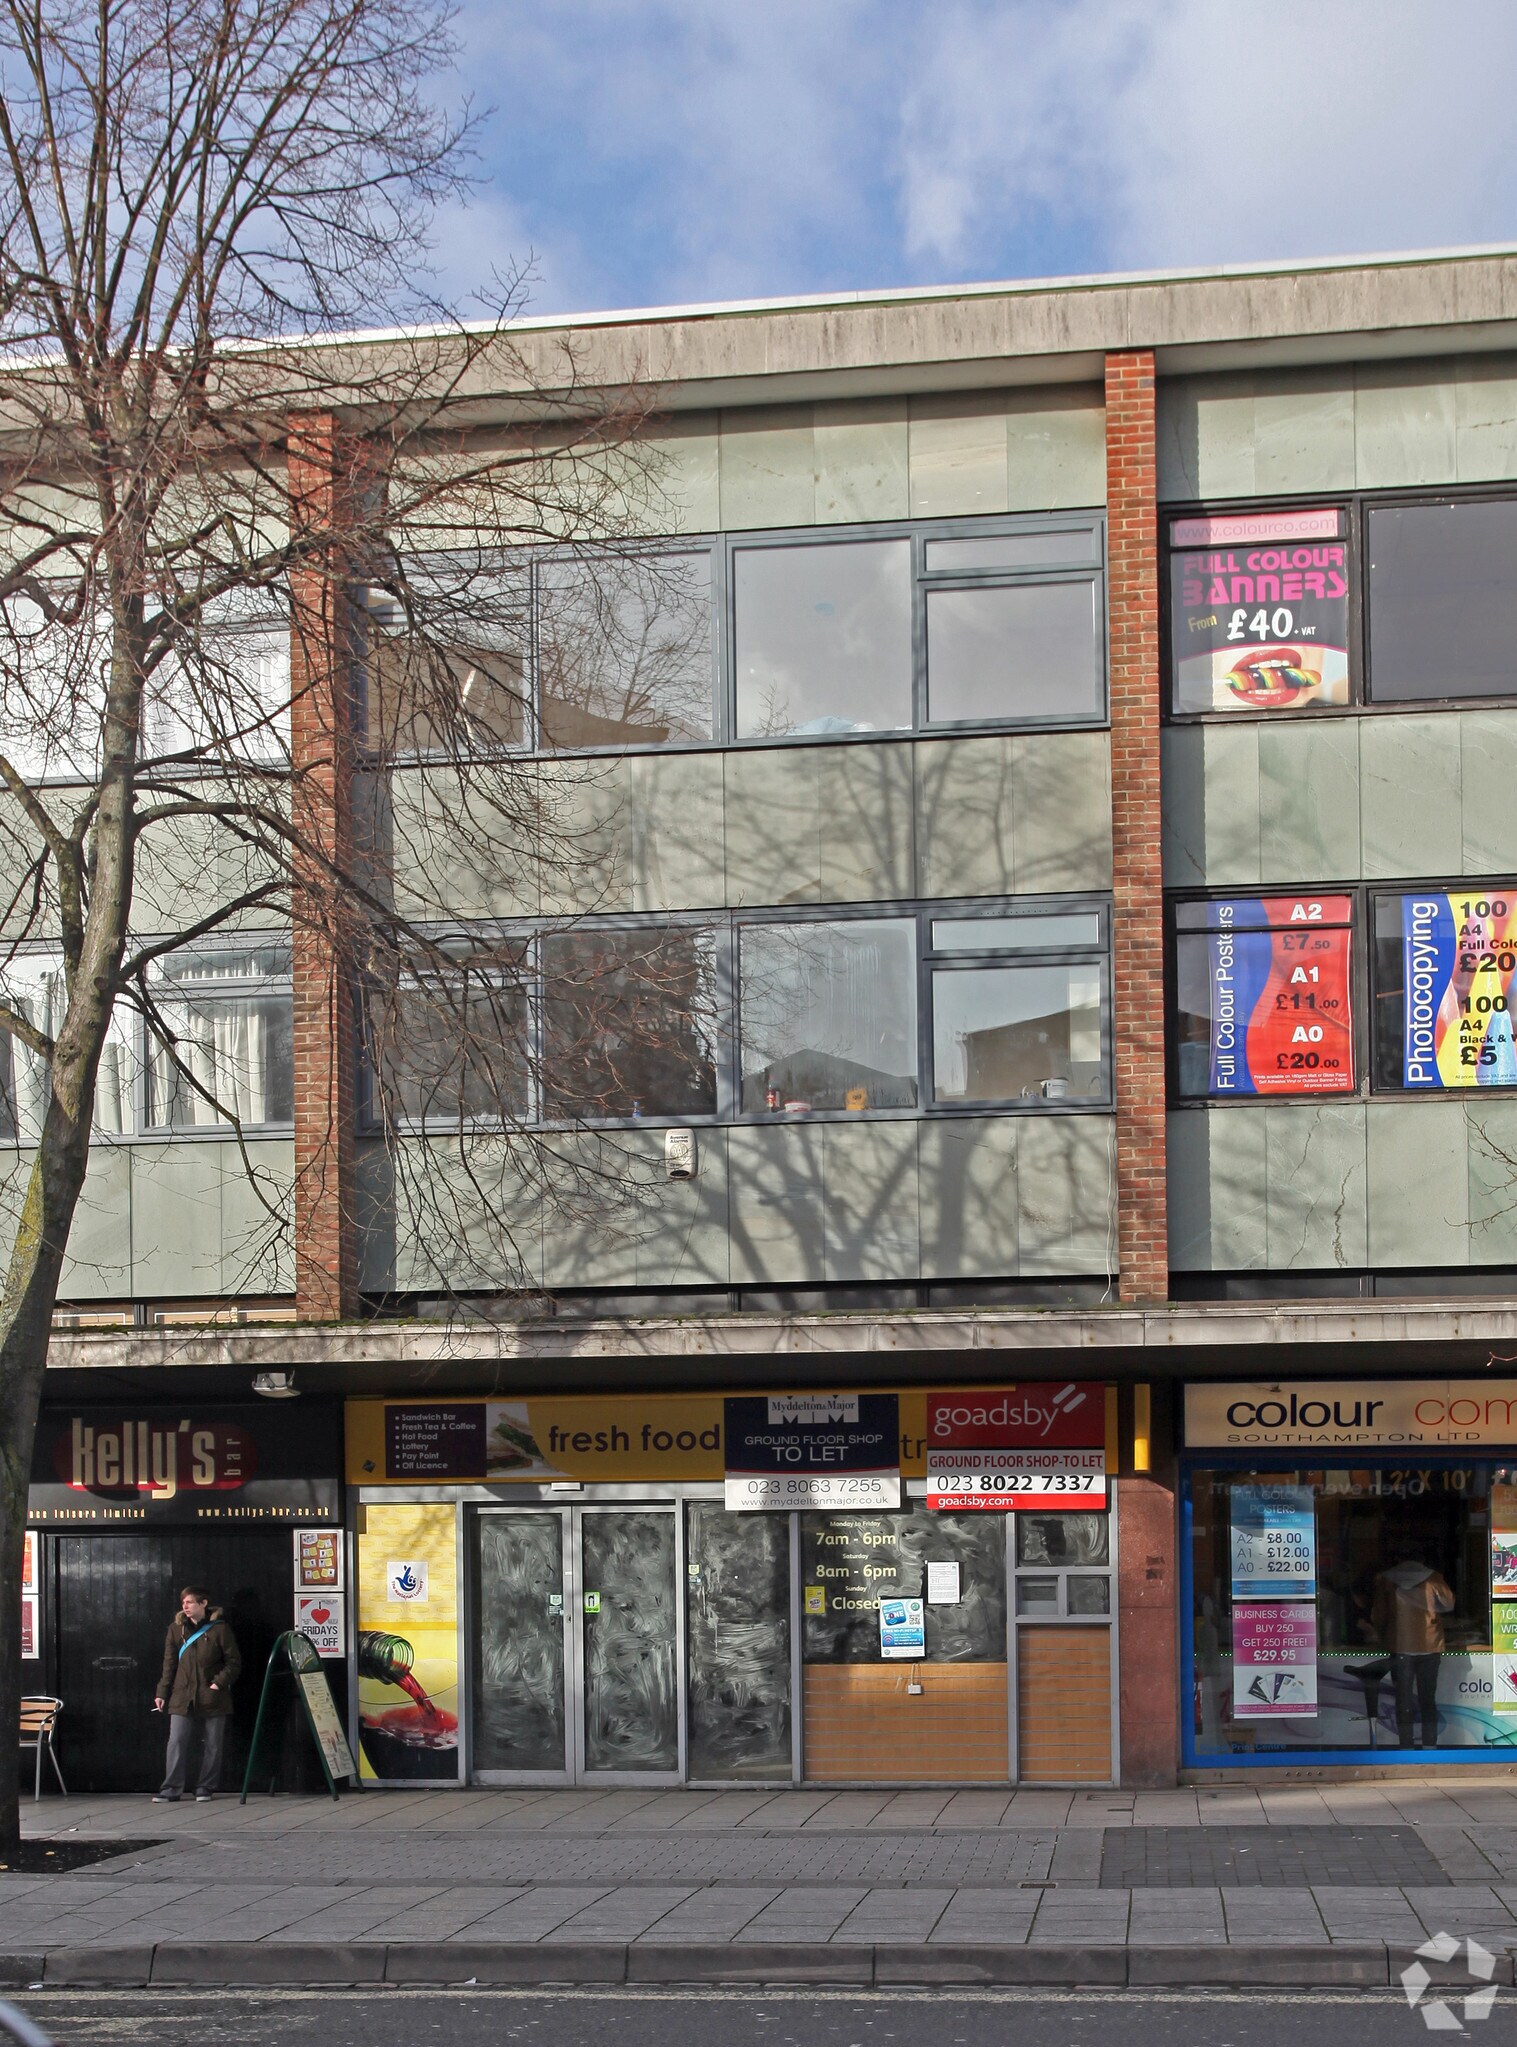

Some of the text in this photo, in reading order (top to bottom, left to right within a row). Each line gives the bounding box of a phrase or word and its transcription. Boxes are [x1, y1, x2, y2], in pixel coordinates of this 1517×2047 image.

[1177, 518, 1336, 540] www.colourco.com
[1184, 548, 1343, 575] FULL COLOUR
[1183, 571, 1347, 606] BANNERS
[1188, 615, 1218, 632] From
[1226, 607, 1293, 641] £40
[1301, 626, 1315, 635] VAT
[1290, 903, 1322, 921] A2
[1460, 900, 1507, 918] 100
[1459, 924, 1482, 936] A4
[1282, 934, 1330, 951] £7.50
[1459, 939, 1485, 951] Full
[1459, 952, 1516, 973] £20
[1290, 967, 1319, 983] A1
[1215, 906, 1235, 1089] Full Colour Posters
[1407, 901, 1439, 1083] Photocopying
[1276, 993, 1338, 1010] £11.00
[1461, 995, 1508, 1014] 100
[1460, 1019, 1483, 1031] A4
[1292, 1026, 1323, 1042] A0
[1460, 1034, 1494, 1044] Black
[1497, 1034, 1507, 1043] &
[1277, 1053, 1339, 1069] £20.00
[1460, 1046, 1498, 1067] £5
[1226, 1393, 1384, 1427] colour
[402, 1413, 456, 1421] Sandwich Bar
[934, 1399, 1060, 1437] goadsby
[449, 1422, 477, 1430] Coffee
[549, 1425, 630, 1452] fresh
[641, 1424, 720, 1452] food
[744, 1434, 884, 1446] GROUND FLOOR SHOP
[1227, 1433, 1480, 1443] SOUTHAMPTON LTD
[402, 1443, 429, 1451] Lottery
[224, 1438, 241, 1476] bar
[420, 1452, 439, 1460] Point
[772, 1446, 849, 1462] TO LET
[930, 1455, 981, 1468] GROUND
[984, 1455, 1024, 1468] FLOOR
[1082, 1455, 1103, 1468] LET
[748, 1479, 882, 1494] 023 8063 7255
[937, 1475, 1095, 1491] 023 8022 7337
[741, 1496, 889, 1509] www.myddeltonmajor.co.uk
[938, 1496, 1014, 1509] goadsby.com
[1250, 1504, 1295, 1514] POSTERS
[54, 1508, 97, 1519] leisure
[103, 1508, 145, 1519] limited
[198, 1507, 329, 1518] www.kellys-bar.co.uk
[830, 1520, 854, 1528] Monday
[862, 1519, 881, 1528] Friday
[816, 1532, 849, 1545] 7am
[863, 1532, 896, 1548] 6pm
[1237, 1534, 1253, 1544] A2
[1267, 1533, 1302, 1544] £8.00
[1237, 1548, 1252, 1558] A1
[1267, 1547, 1310, 1558] £12.00
[816, 1564, 850, 1578] 8am
[863, 1564, 897, 1580] 6pm
[1237, 1562, 1254, 1573] A0
[1267, 1561, 1310, 1572] £22.00
[845, 1585, 868, 1593] Sunday
[832, 1596, 880, 1610] Closed
[885, 1610, 905, 1620] ZONE
[1234, 1609, 1314, 1620] BUSINESS CARDS
[302, 1626, 338, 1635] FRIDAYS
[1255, 1623, 1294, 1633] BUY 250
[322, 1638, 338, 1647] OFF
[1242, 1637, 1307, 1647] GET 250 FREE!
[1254, 1649, 1296, 1661] £29.95
[1459, 1678, 1493, 1693] colo
